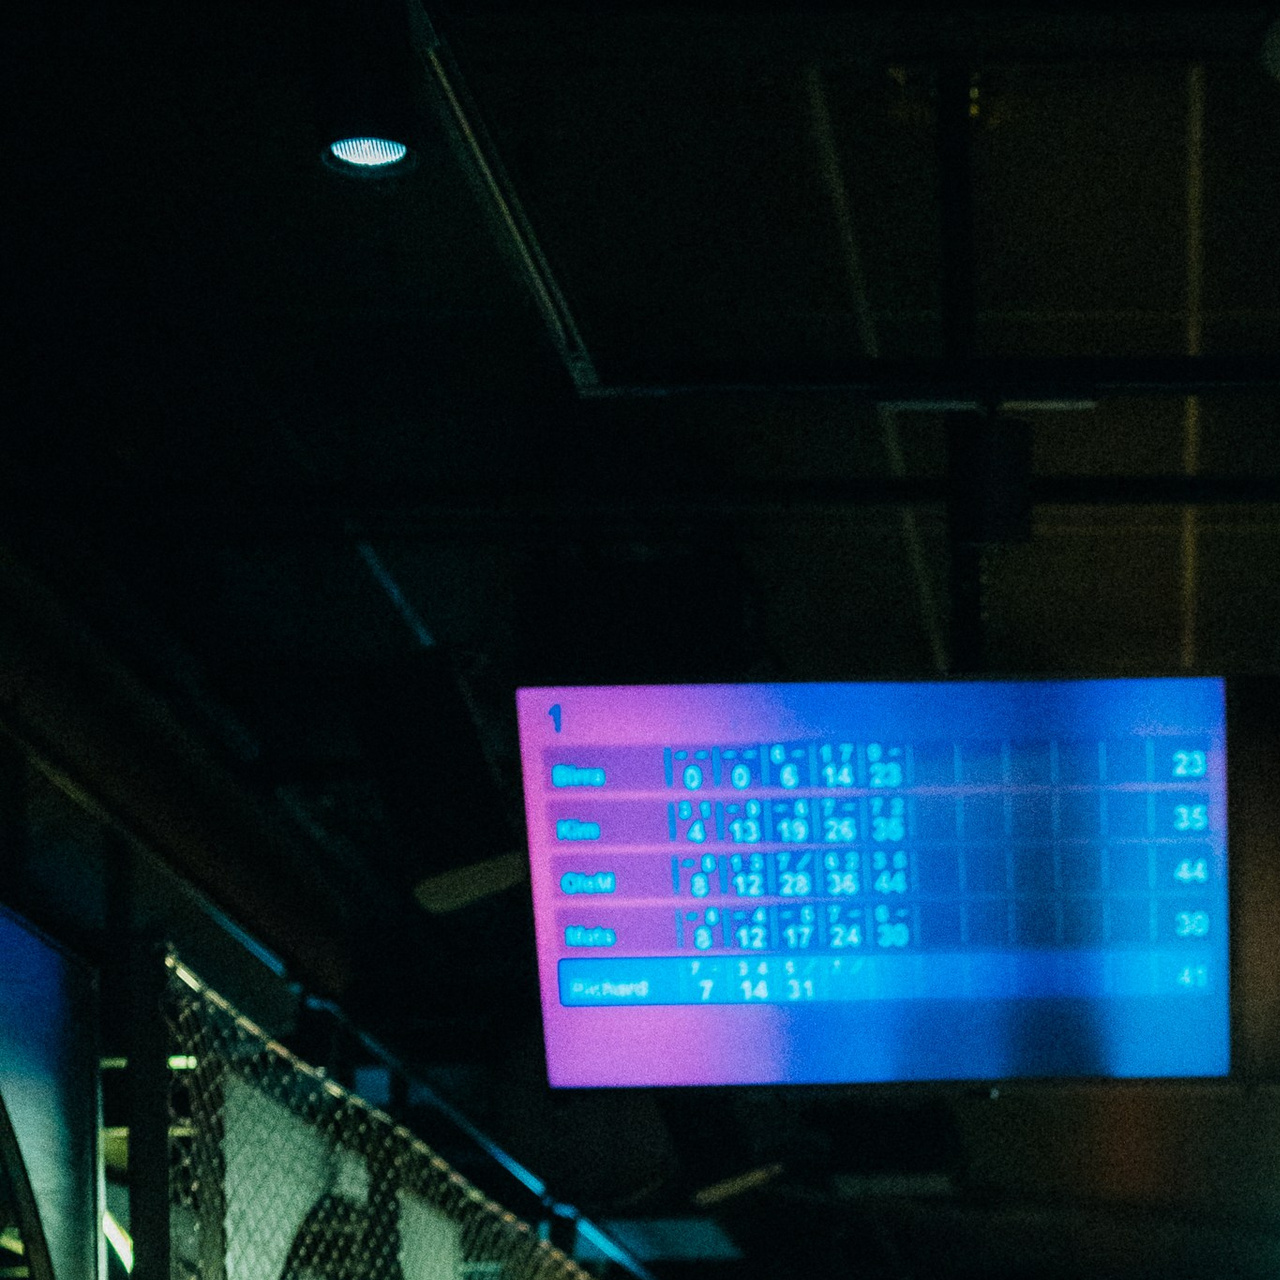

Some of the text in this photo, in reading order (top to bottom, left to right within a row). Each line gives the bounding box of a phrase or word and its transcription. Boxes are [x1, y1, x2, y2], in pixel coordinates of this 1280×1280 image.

[548, 704, 562, 733] 1
[822, 763, 854, 789] 14
[1172, 750, 1207, 777] 23
[732, 872, 764, 898] 12
[1174, 858, 1209, 883] 44
[736, 925, 768, 950] 12
[782, 924, 815, 949] 17
[699, 979, 714, 1001] 7
[740, 979, 769, 1000] 14
[787, 978, 814, 1000] 31
